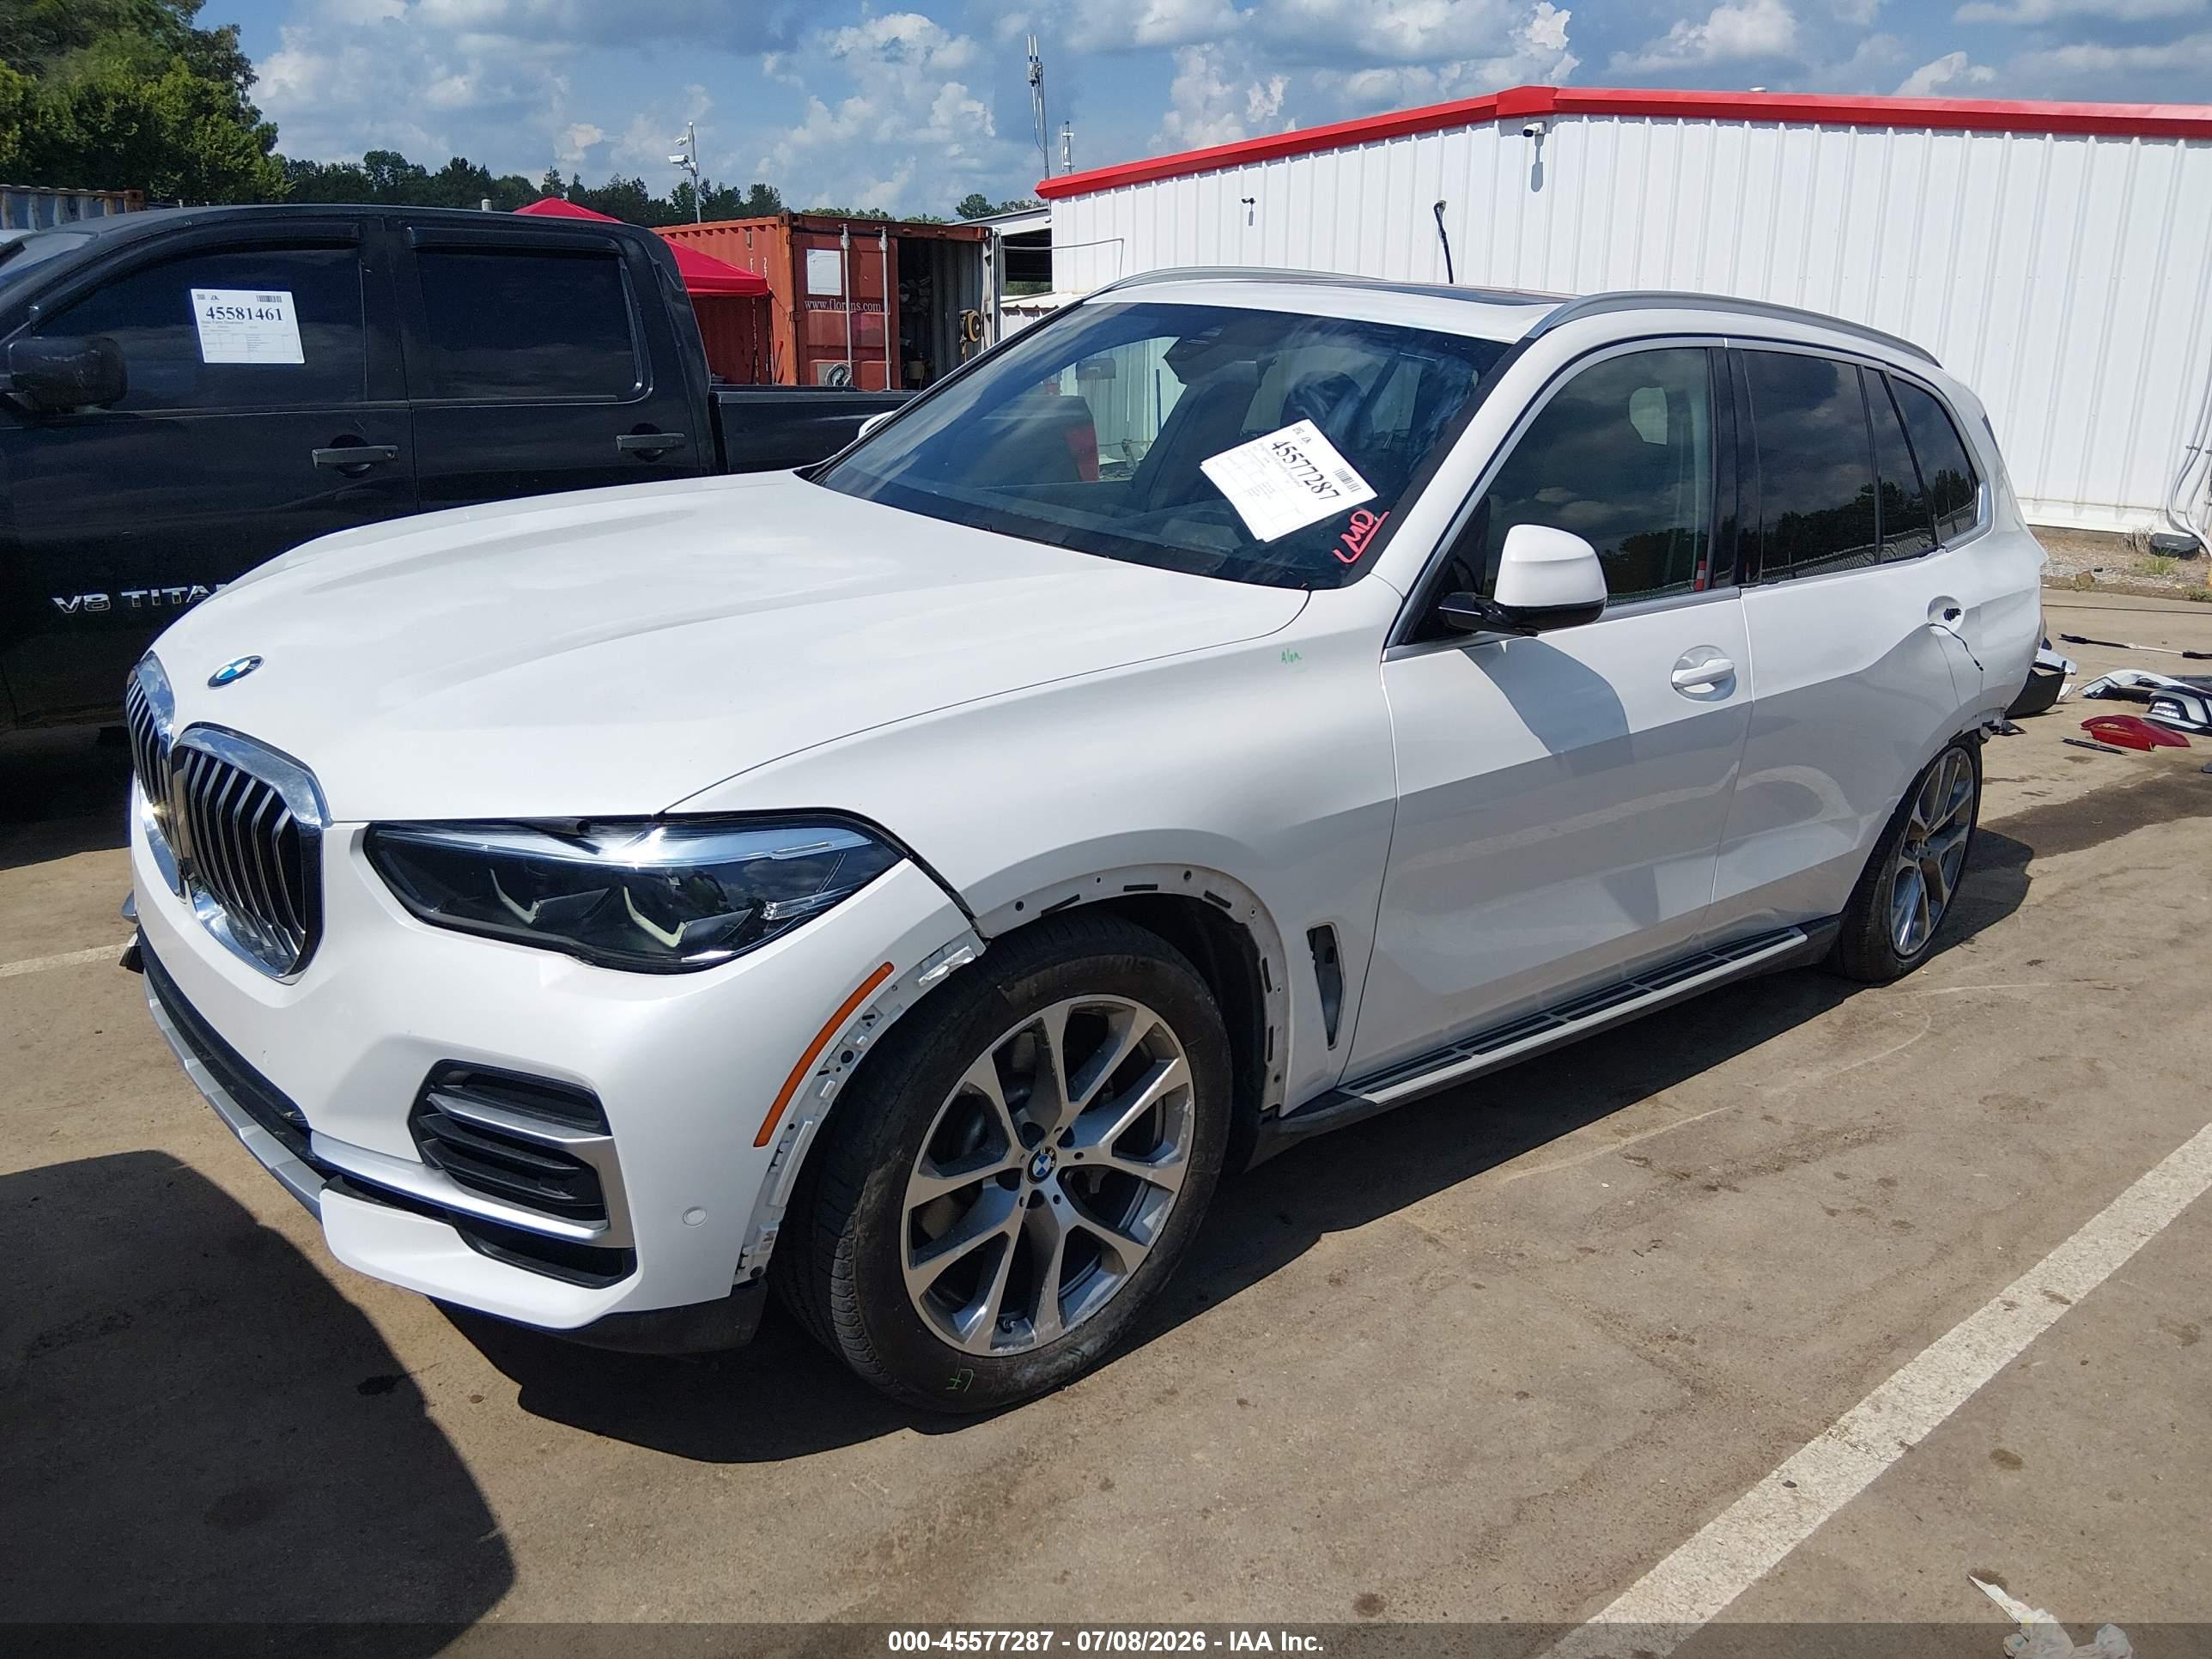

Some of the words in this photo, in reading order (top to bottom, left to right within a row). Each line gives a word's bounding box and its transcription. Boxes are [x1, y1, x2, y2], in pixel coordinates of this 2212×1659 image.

[205, 306, 283, 321] 45581461
[805, 298, 881, 313] www.florns.com
[1272, 441, 1341, 500] 45577287
[52, 594, 111, 614] V8
